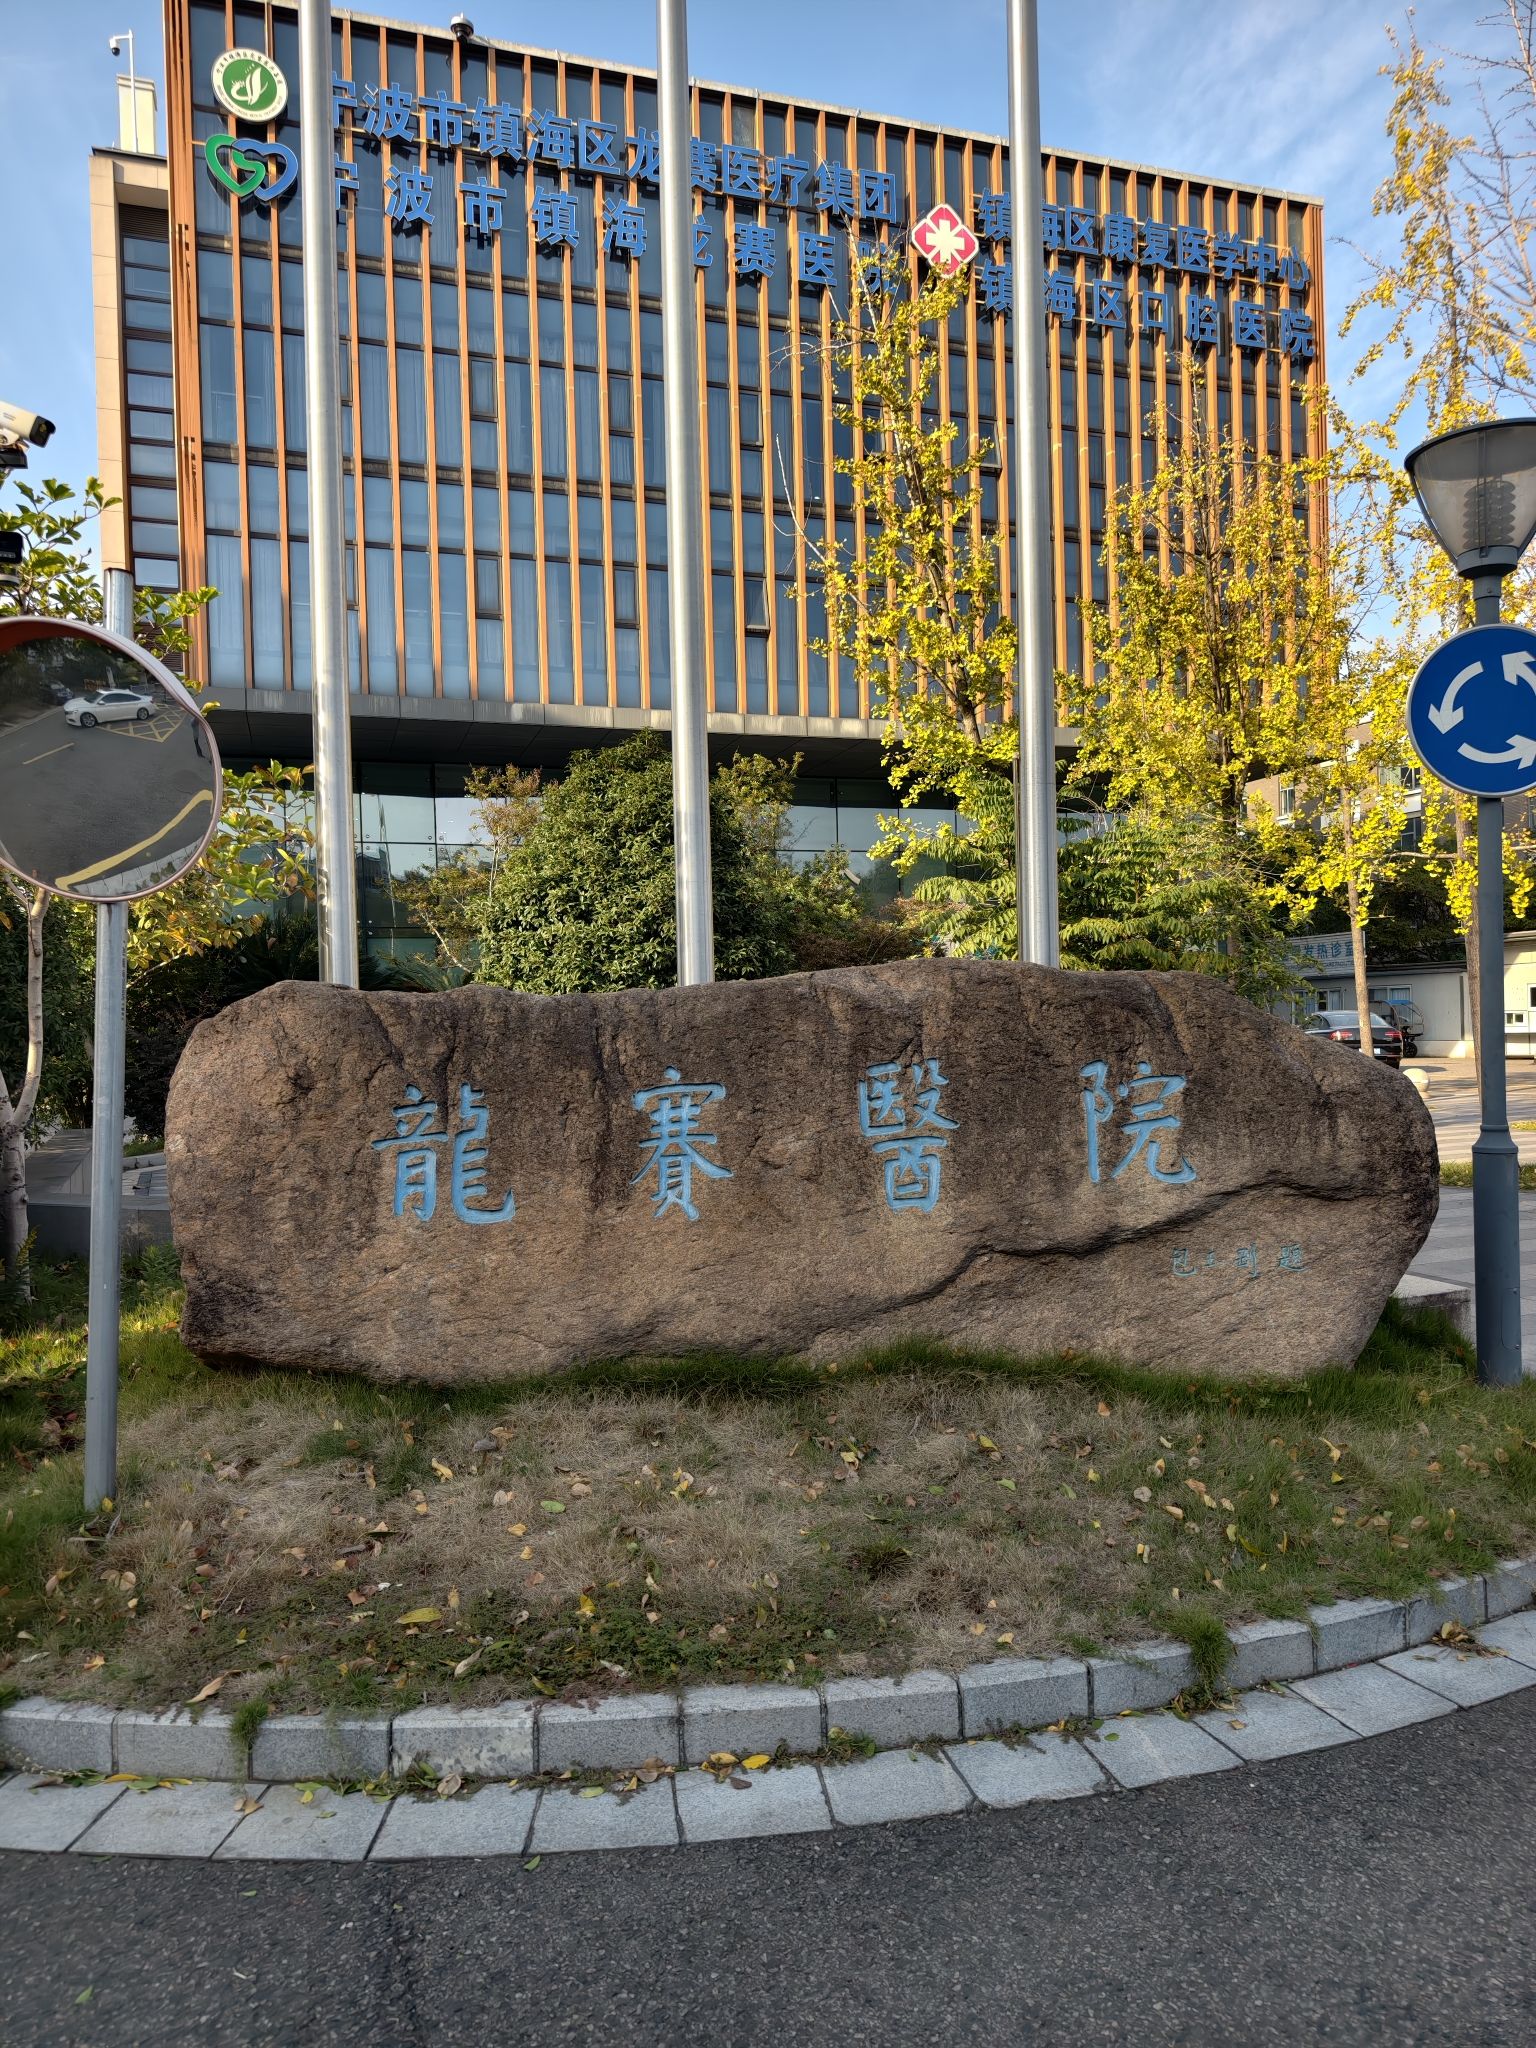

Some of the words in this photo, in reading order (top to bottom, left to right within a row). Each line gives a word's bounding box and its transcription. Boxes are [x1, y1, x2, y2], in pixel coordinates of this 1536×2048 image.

[980, 258, 1315, 356] 镇海区口腔医院
